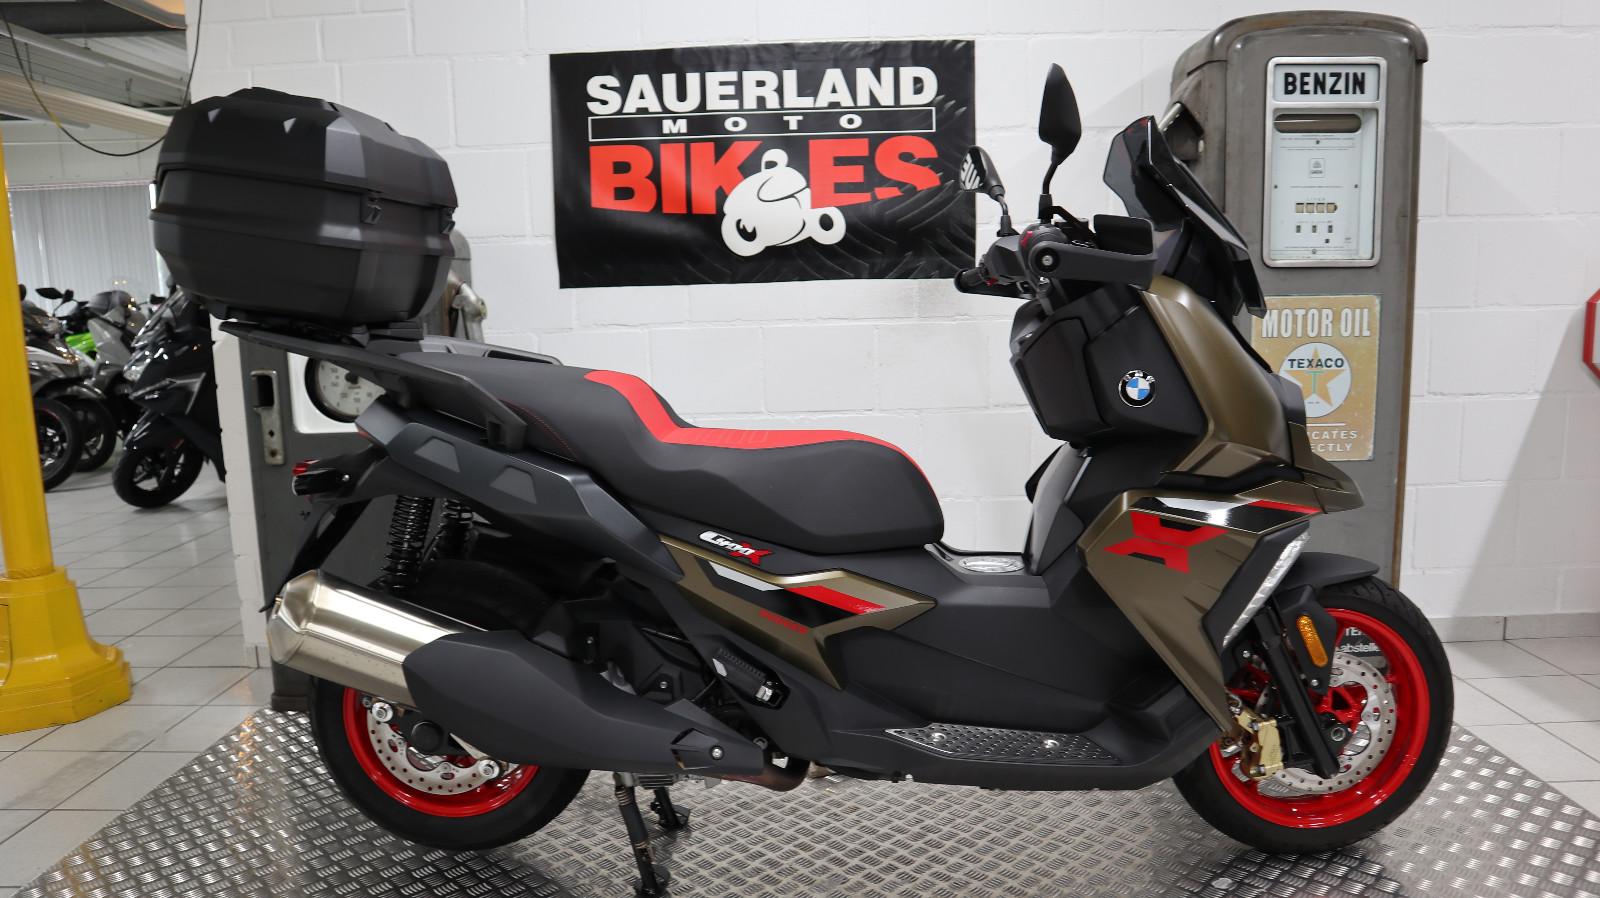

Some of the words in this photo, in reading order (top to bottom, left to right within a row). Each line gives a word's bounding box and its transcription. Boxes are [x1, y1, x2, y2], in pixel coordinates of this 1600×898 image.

[586, 66, 938, 115] SAUERLAND
[1284, 71, 1366, 95] BENZIN
[662, 113, 863, 134] MOTO
[1261, 308, 1333, 338] MOTOR
[1340, 307, 1372, 338] OIL
[1288, 357, 1345, 369] TEXACO
